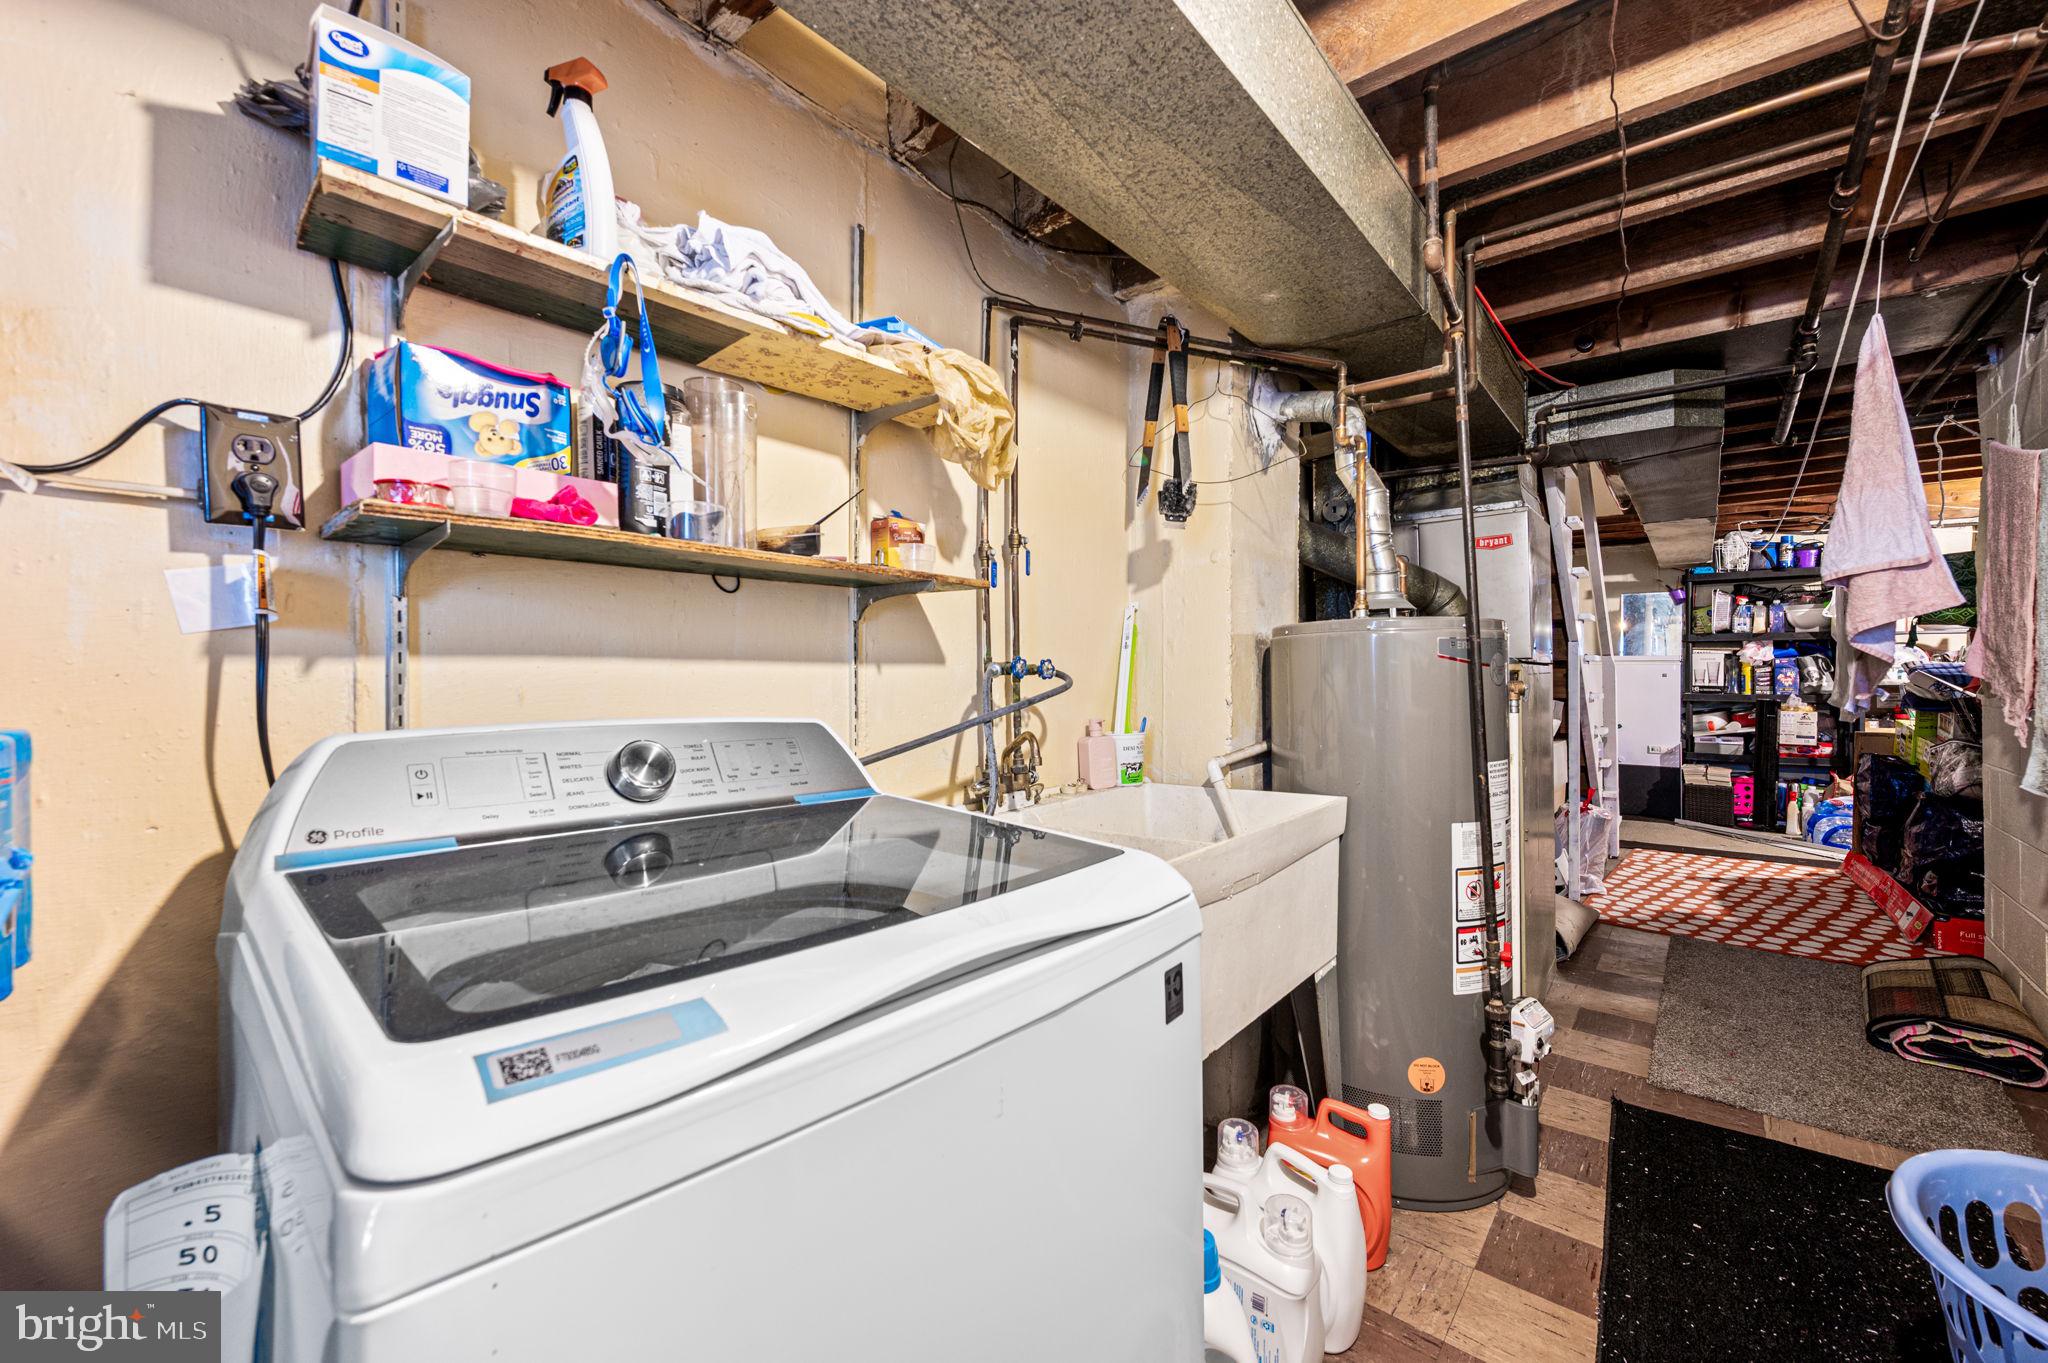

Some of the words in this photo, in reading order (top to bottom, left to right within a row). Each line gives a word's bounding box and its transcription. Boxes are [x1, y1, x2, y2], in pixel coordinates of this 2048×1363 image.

[437, 384, 541, 418] Snuggle
[410, 430, 443, 444] MORE
[894, 533, 910, 542] Baking
[1480, 536, 1508, 547] bryant
[334, 827, 384, 839] Profile
[178, 1245, 218, 1266] 50
